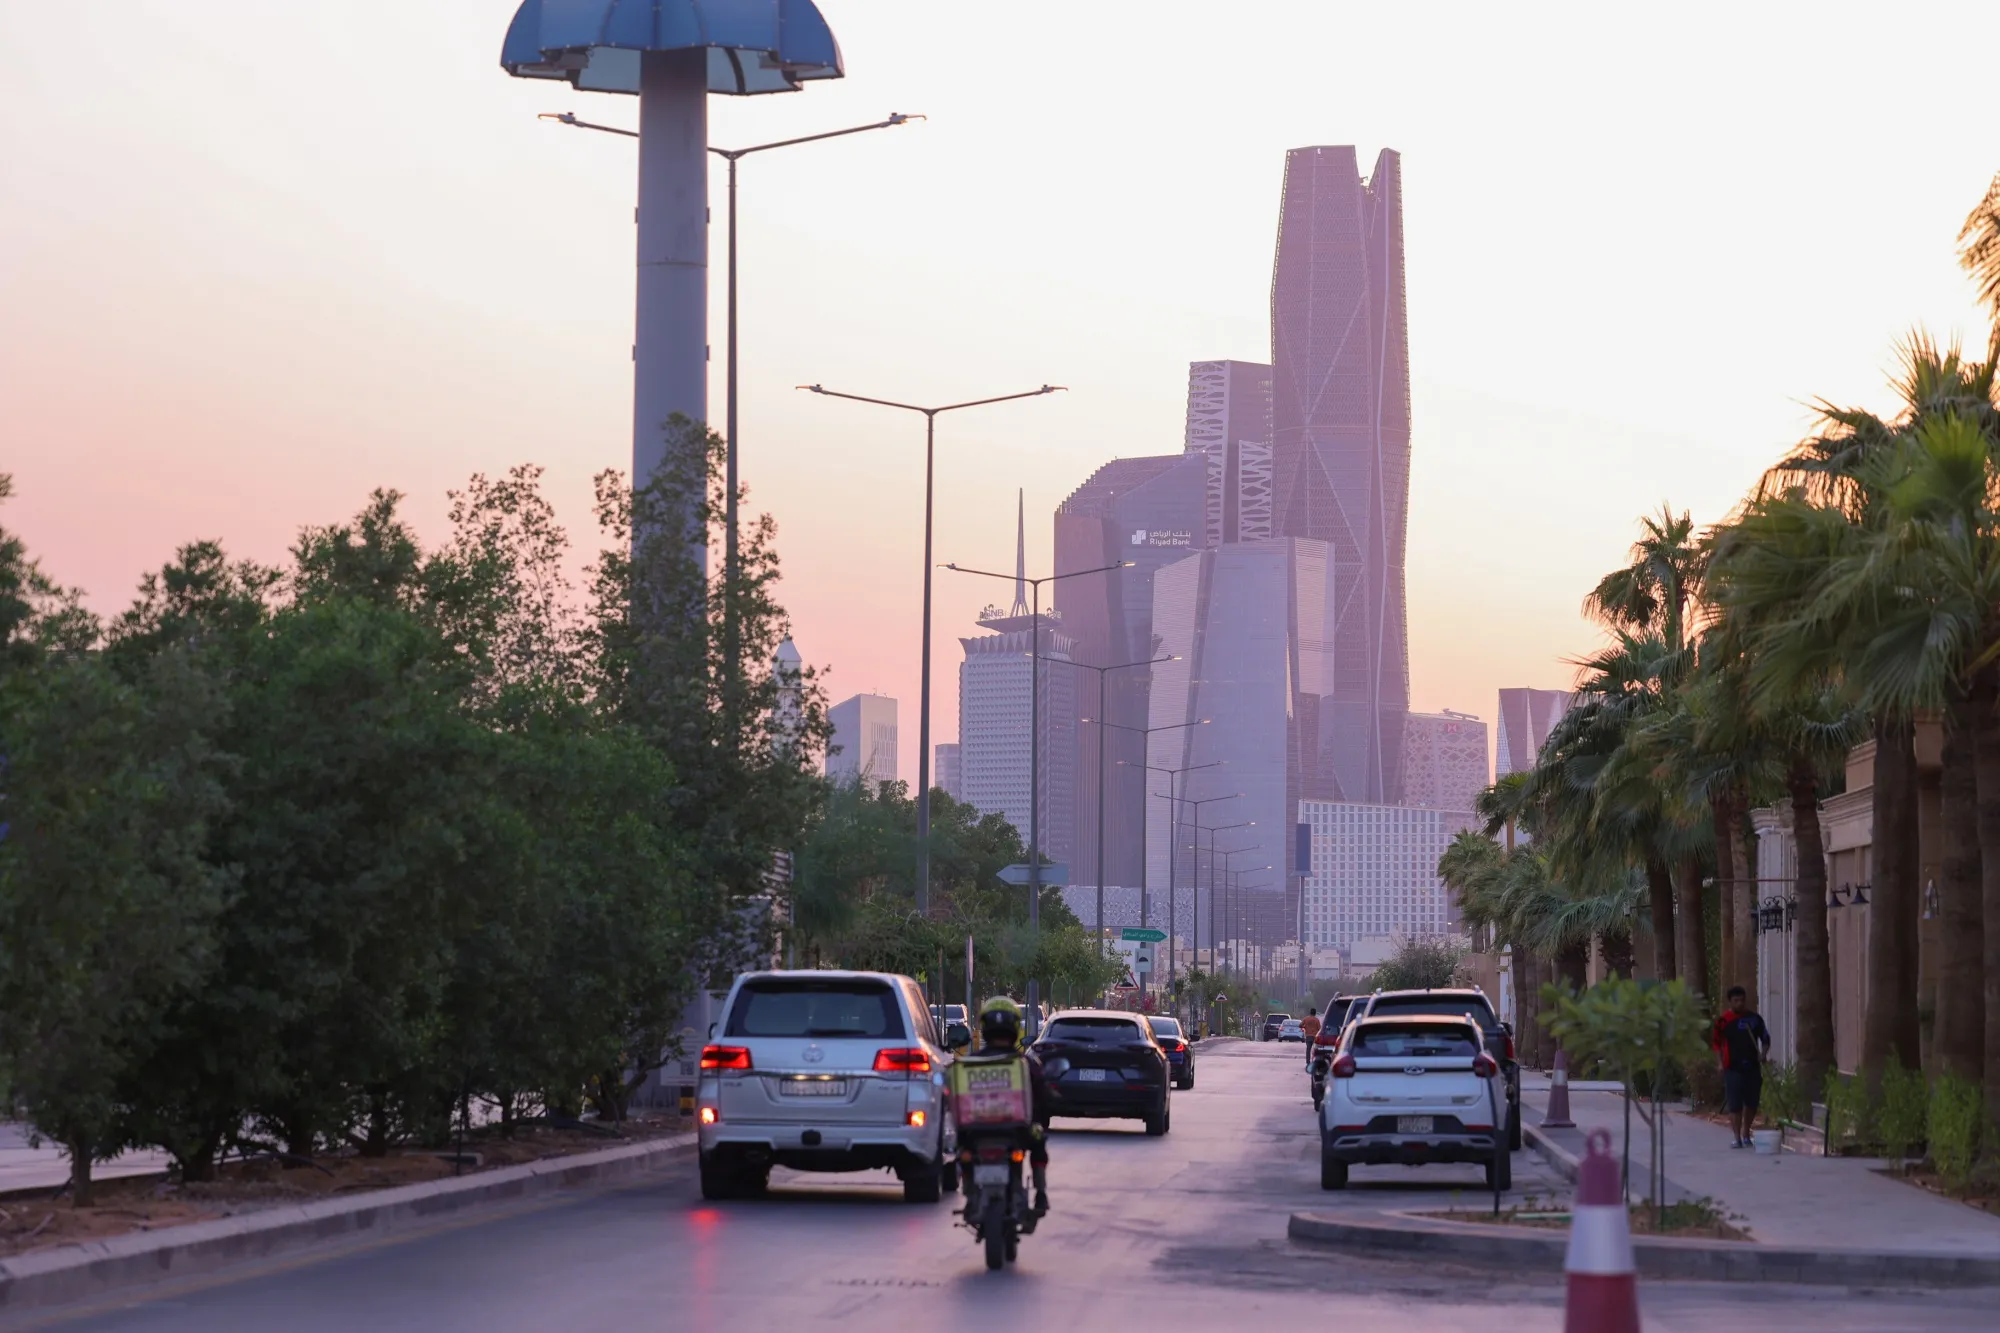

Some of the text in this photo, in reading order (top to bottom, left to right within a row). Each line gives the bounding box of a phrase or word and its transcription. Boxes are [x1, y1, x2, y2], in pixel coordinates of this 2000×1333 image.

[1149, 530, 1191, 538] بنك الرياض
[1149, 538, 1190, 547] Riyad Bank
[968, 1069, 1011, 1081] noon
